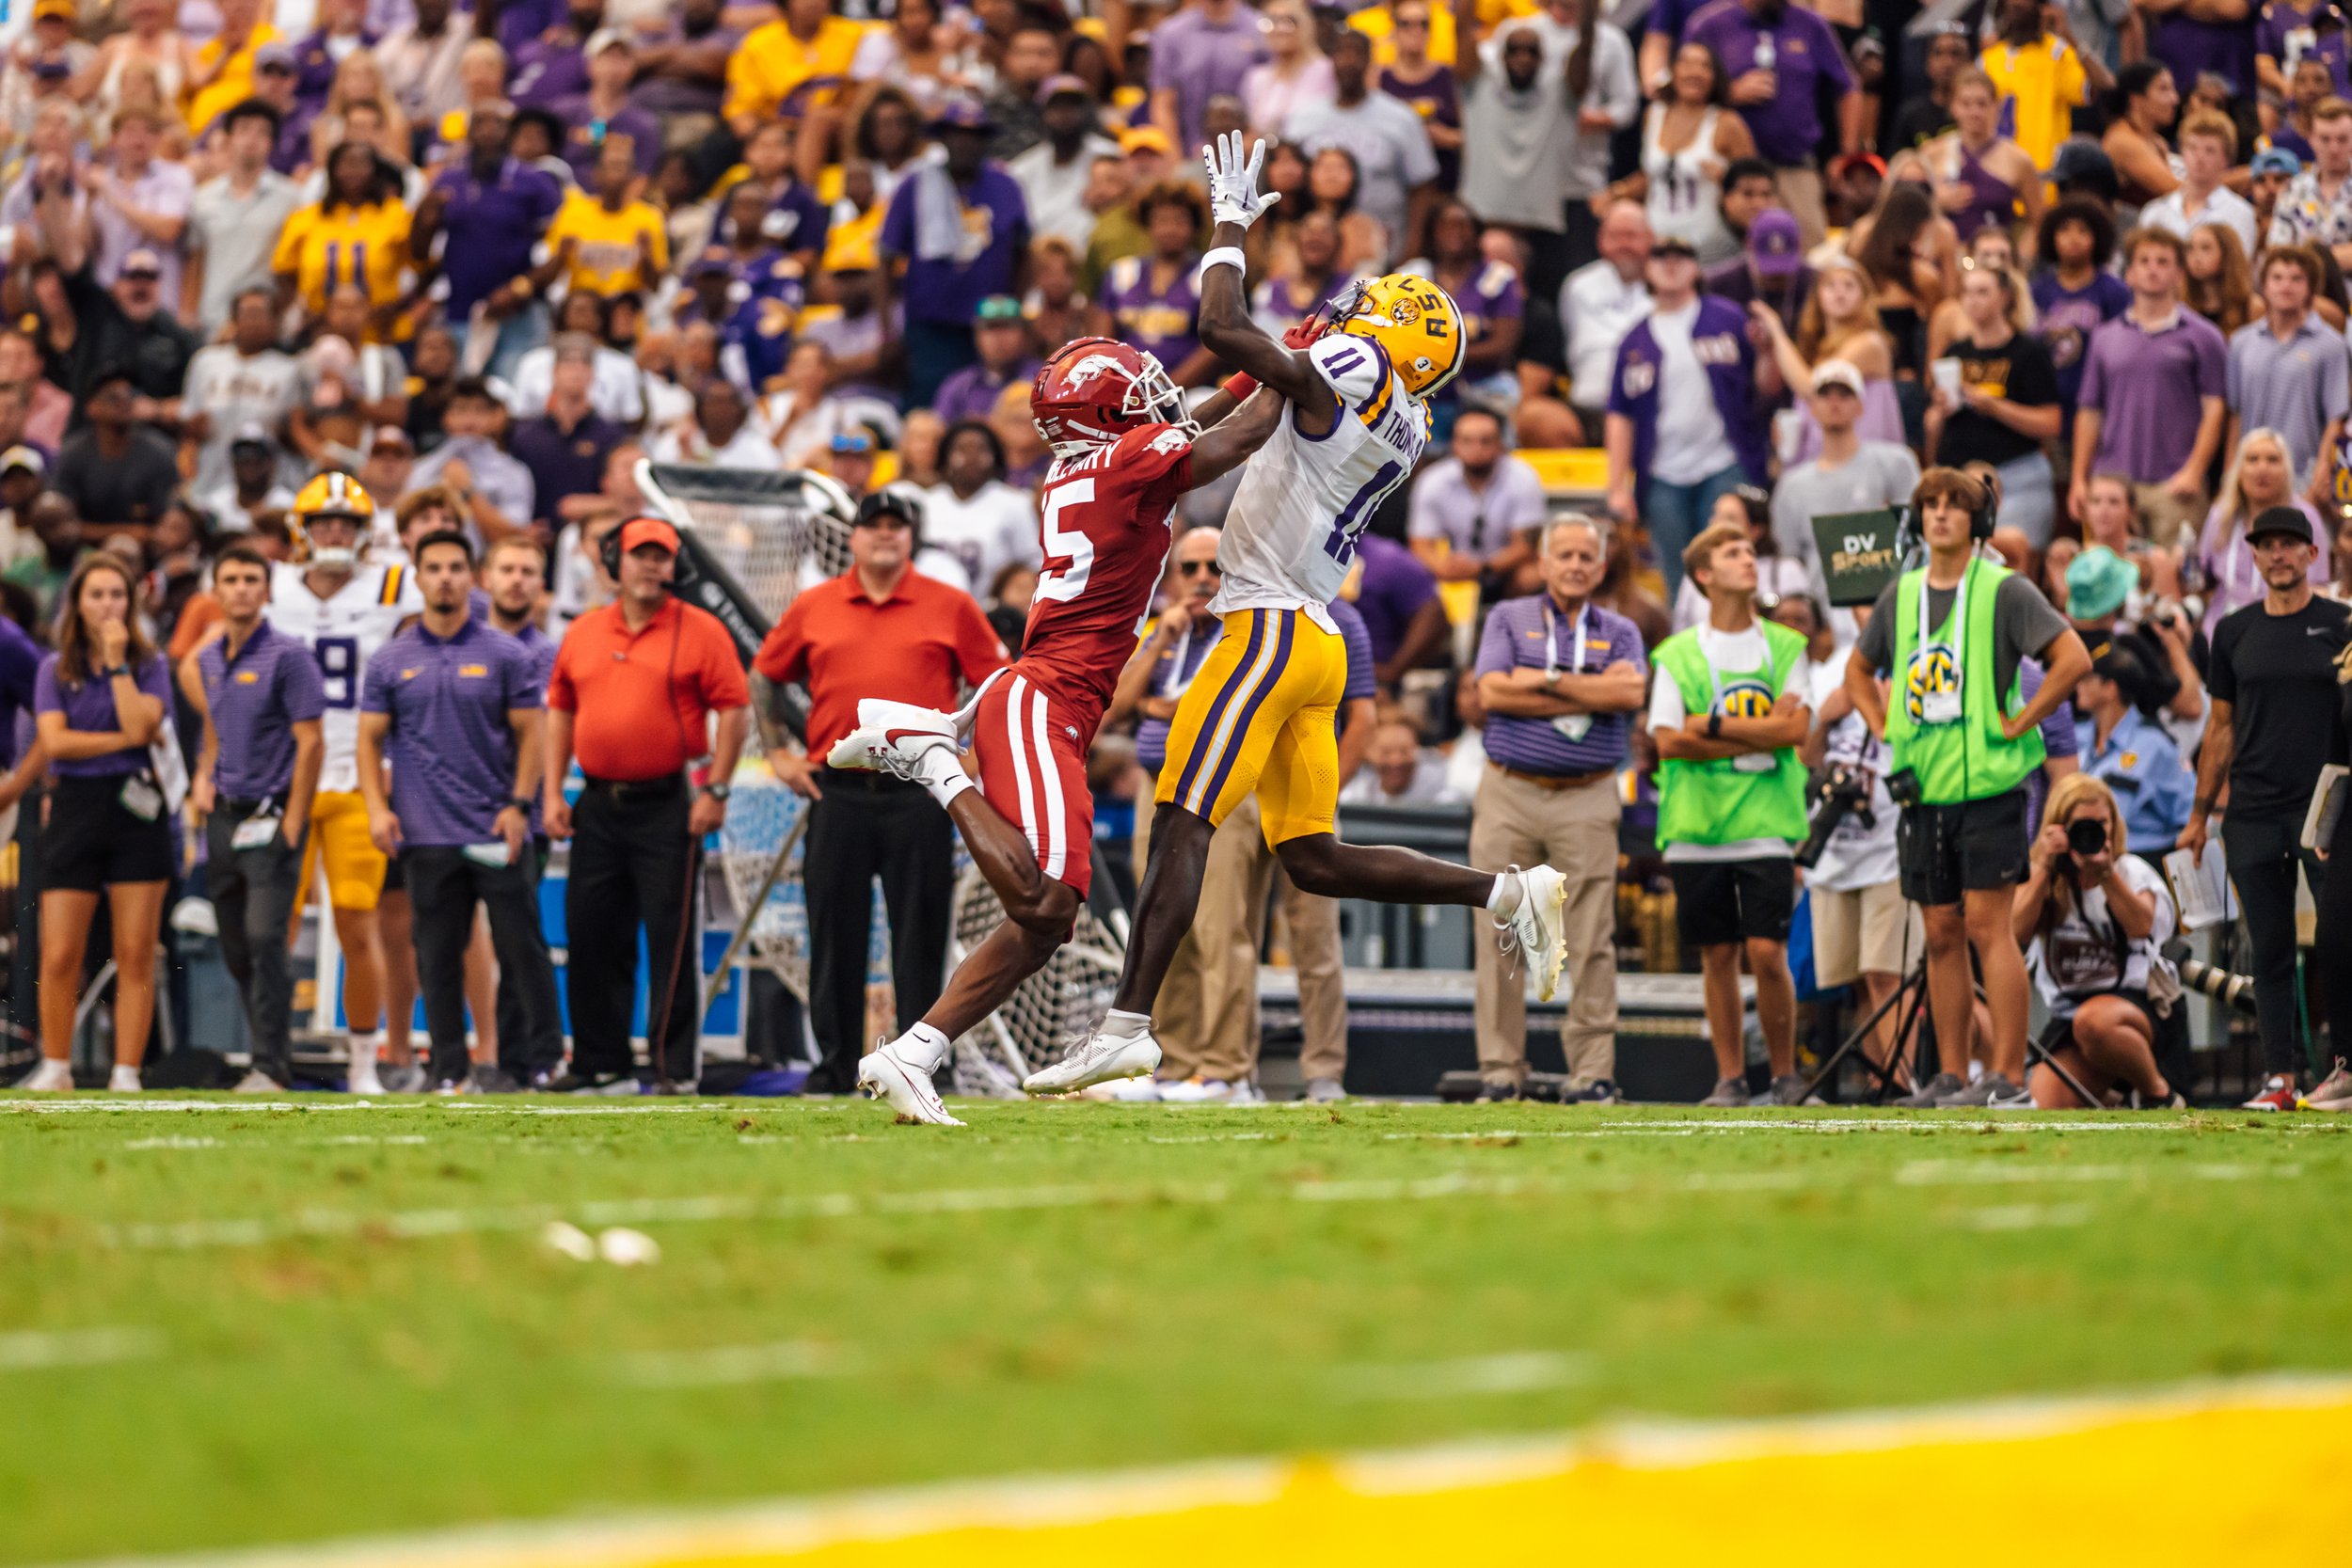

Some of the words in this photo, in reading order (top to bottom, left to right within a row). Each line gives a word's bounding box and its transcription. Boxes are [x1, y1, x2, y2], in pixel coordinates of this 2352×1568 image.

[1321, 347, 1367, 380] 11
[1029, 477, 1095, 610] 5
[1843, 532, 1877, 555] DV
[315, 637, 357, 709] 9
